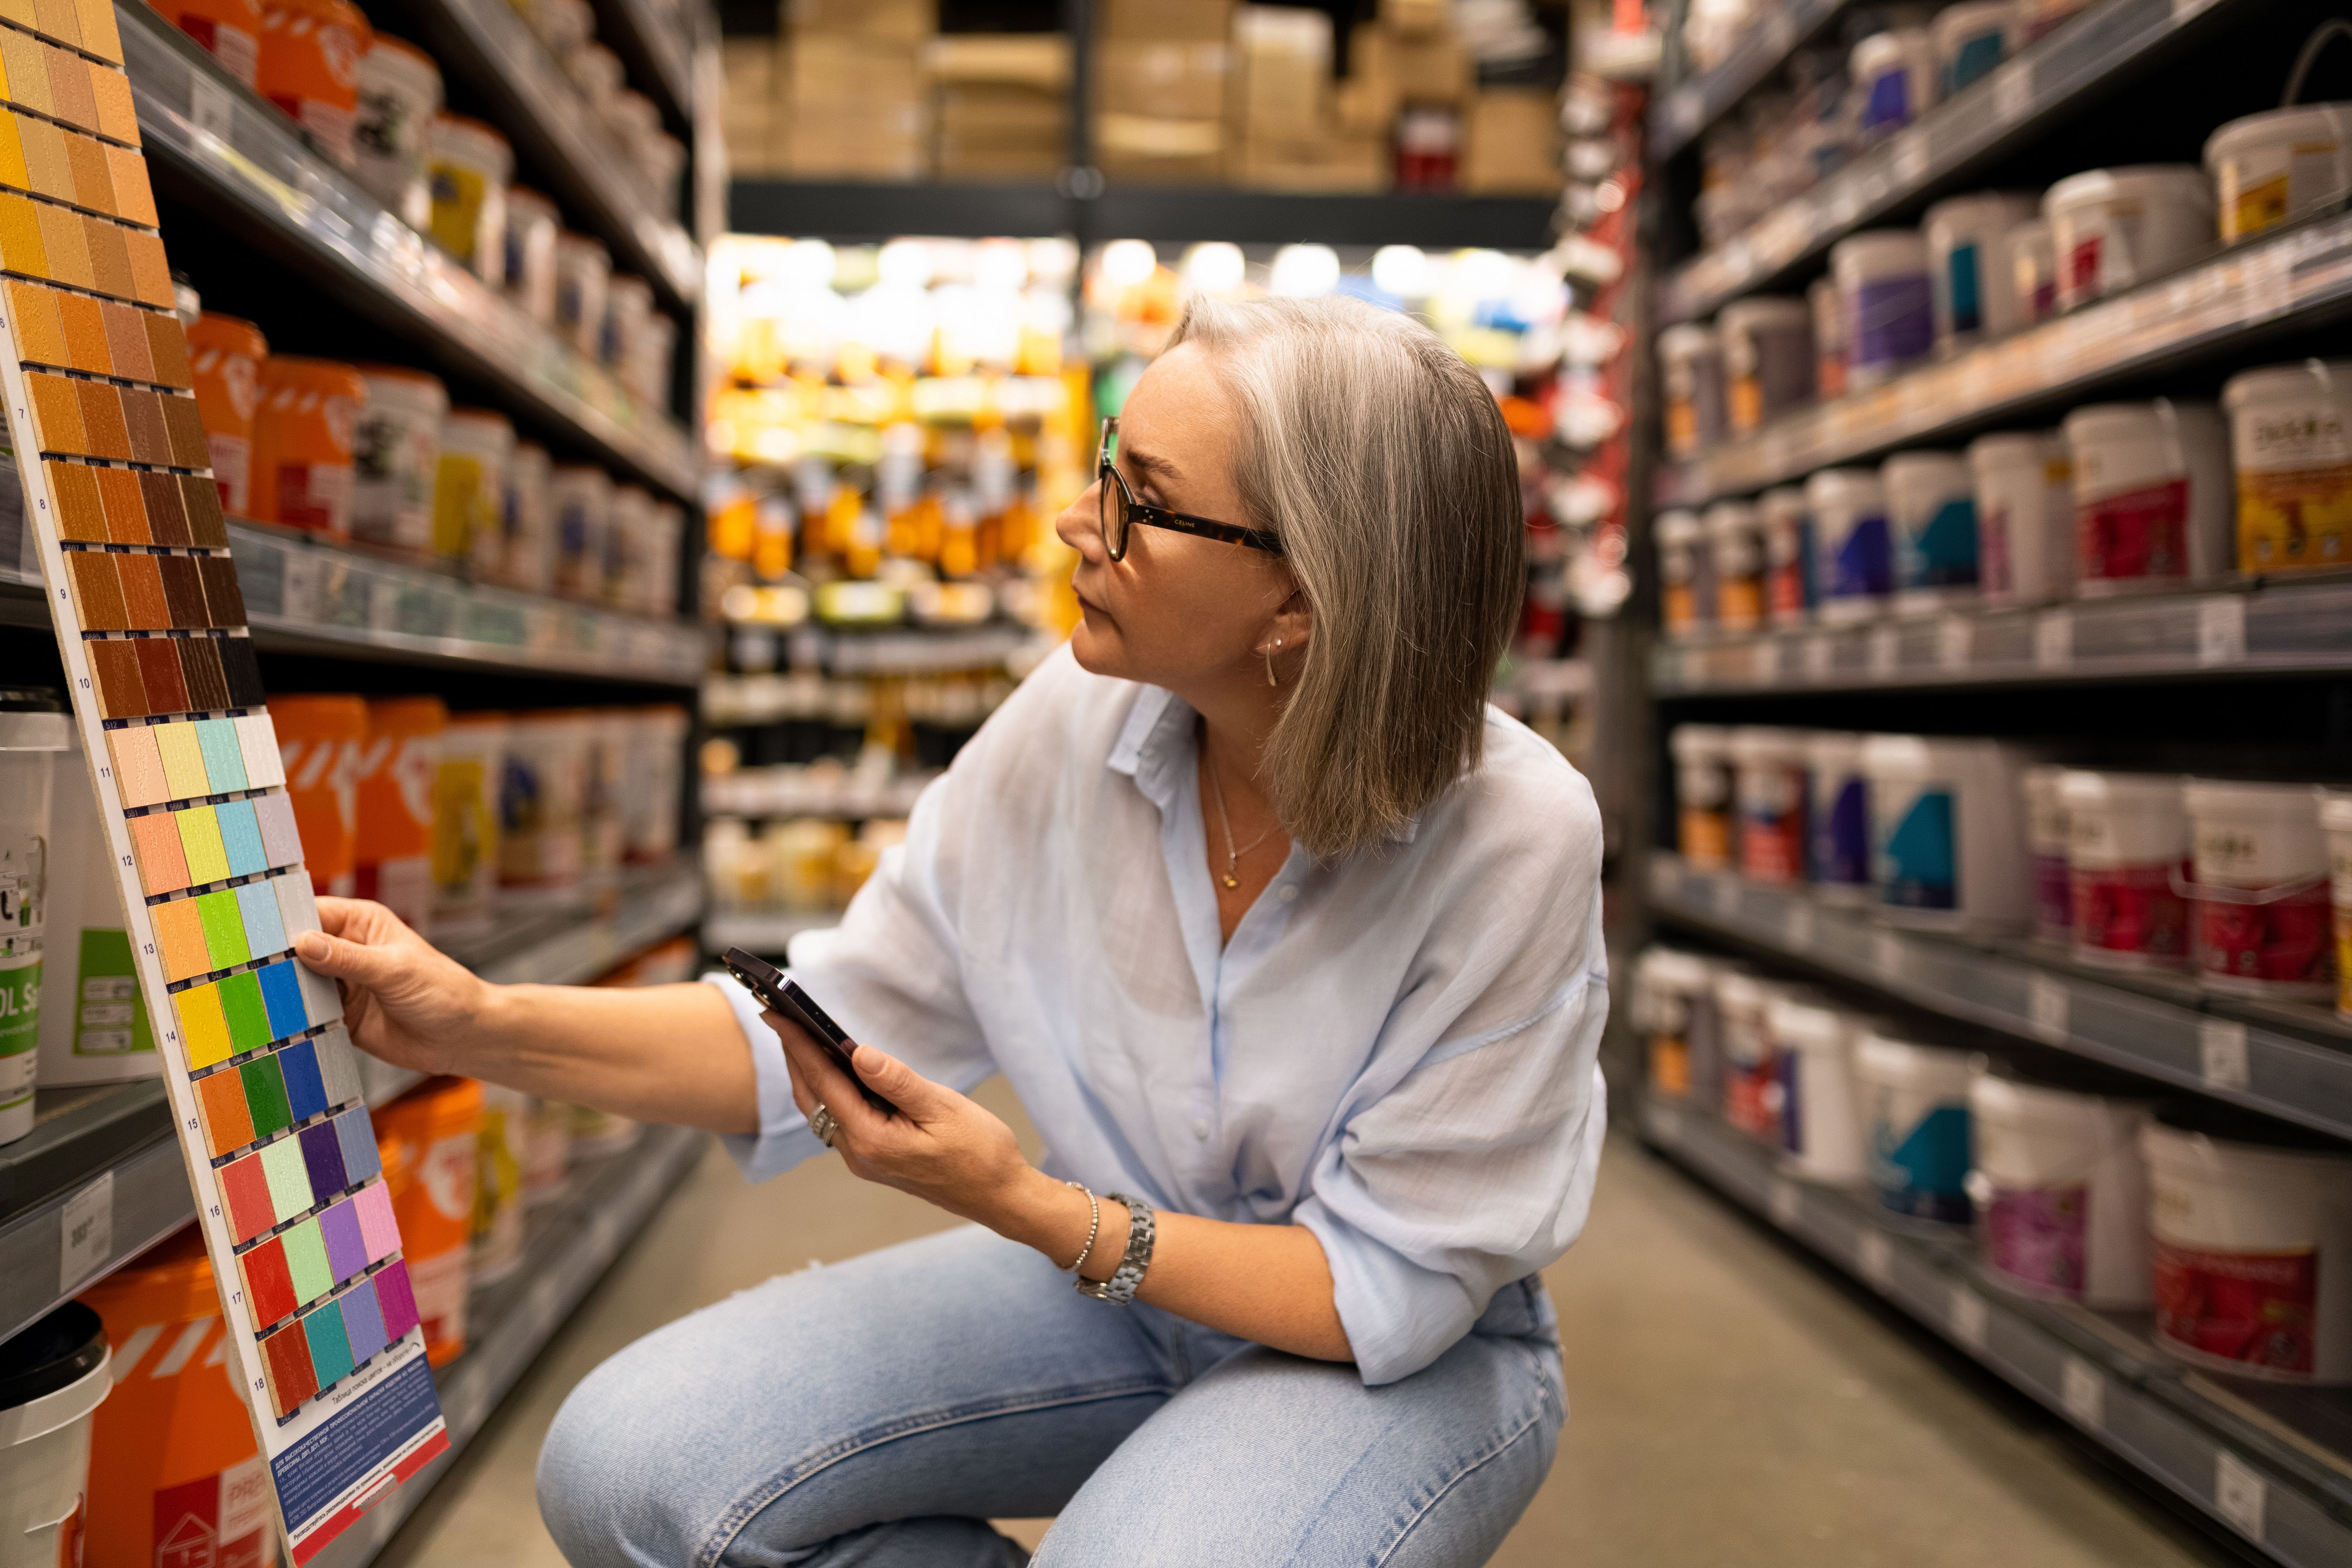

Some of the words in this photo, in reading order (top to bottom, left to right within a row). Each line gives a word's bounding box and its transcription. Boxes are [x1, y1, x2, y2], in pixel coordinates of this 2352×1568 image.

[19, 409, 24, 418] 7
[40, 499, 46, 509] 8
[1175, 519, 1195, 528] CELINE
[60, 589, 66, 599] 9
[79, 678, 90, 689] 10
[101, 767, 110, 778] 11
[170, 802, 184, 811] 5668
[122, 855, 133, 867] 12
[149, 896, 160, 905] 566
[191, 887, 202, 896] 565
[144, 943, 154, 955] 13
[171, 983, 185, 993] 5687
[211, 972, 222, 980] 543
[166, 1031, 176, 1043] 14
[192, 1069, 207, 1080] 5696
[233, 1055, 243, 1064] 544
[188, 1118, 198, 1130] 15
[214, 1157, 225, 1166] 548
[210, 1205, 220, 1218] 16
[237, 1241, 250, 1252] 5604
[232, 1291, 241, 1304] 17
[258, 1329, 269, 1339] 575
[254, 1378, 264, 1392] 18
[332, 1386, 352, 1405] Таблица
[351, 1376, 367, 1392] поиска
[281, 1414, 291, 1425] 542
[275, 1458, 285, 1470] ДЛЯ
[284, 1425, 330, 1462] ВЫСОКОКАЧЕСТВЕННОЙ
[329, 1396, 369, 1429] ПРОФЕССИОНАЛЬНОЙ
[277, 1454, 302, 1478] ДРЕВЕСИНЫ,
[301, 1447, 311, 1460] ДВП,
[310, 1441, 320, 1453] ДСП,
[293, 1511, 326, 1542] Руководствуйтесь
[326, 1488, 355, 1516] рекомендациями
